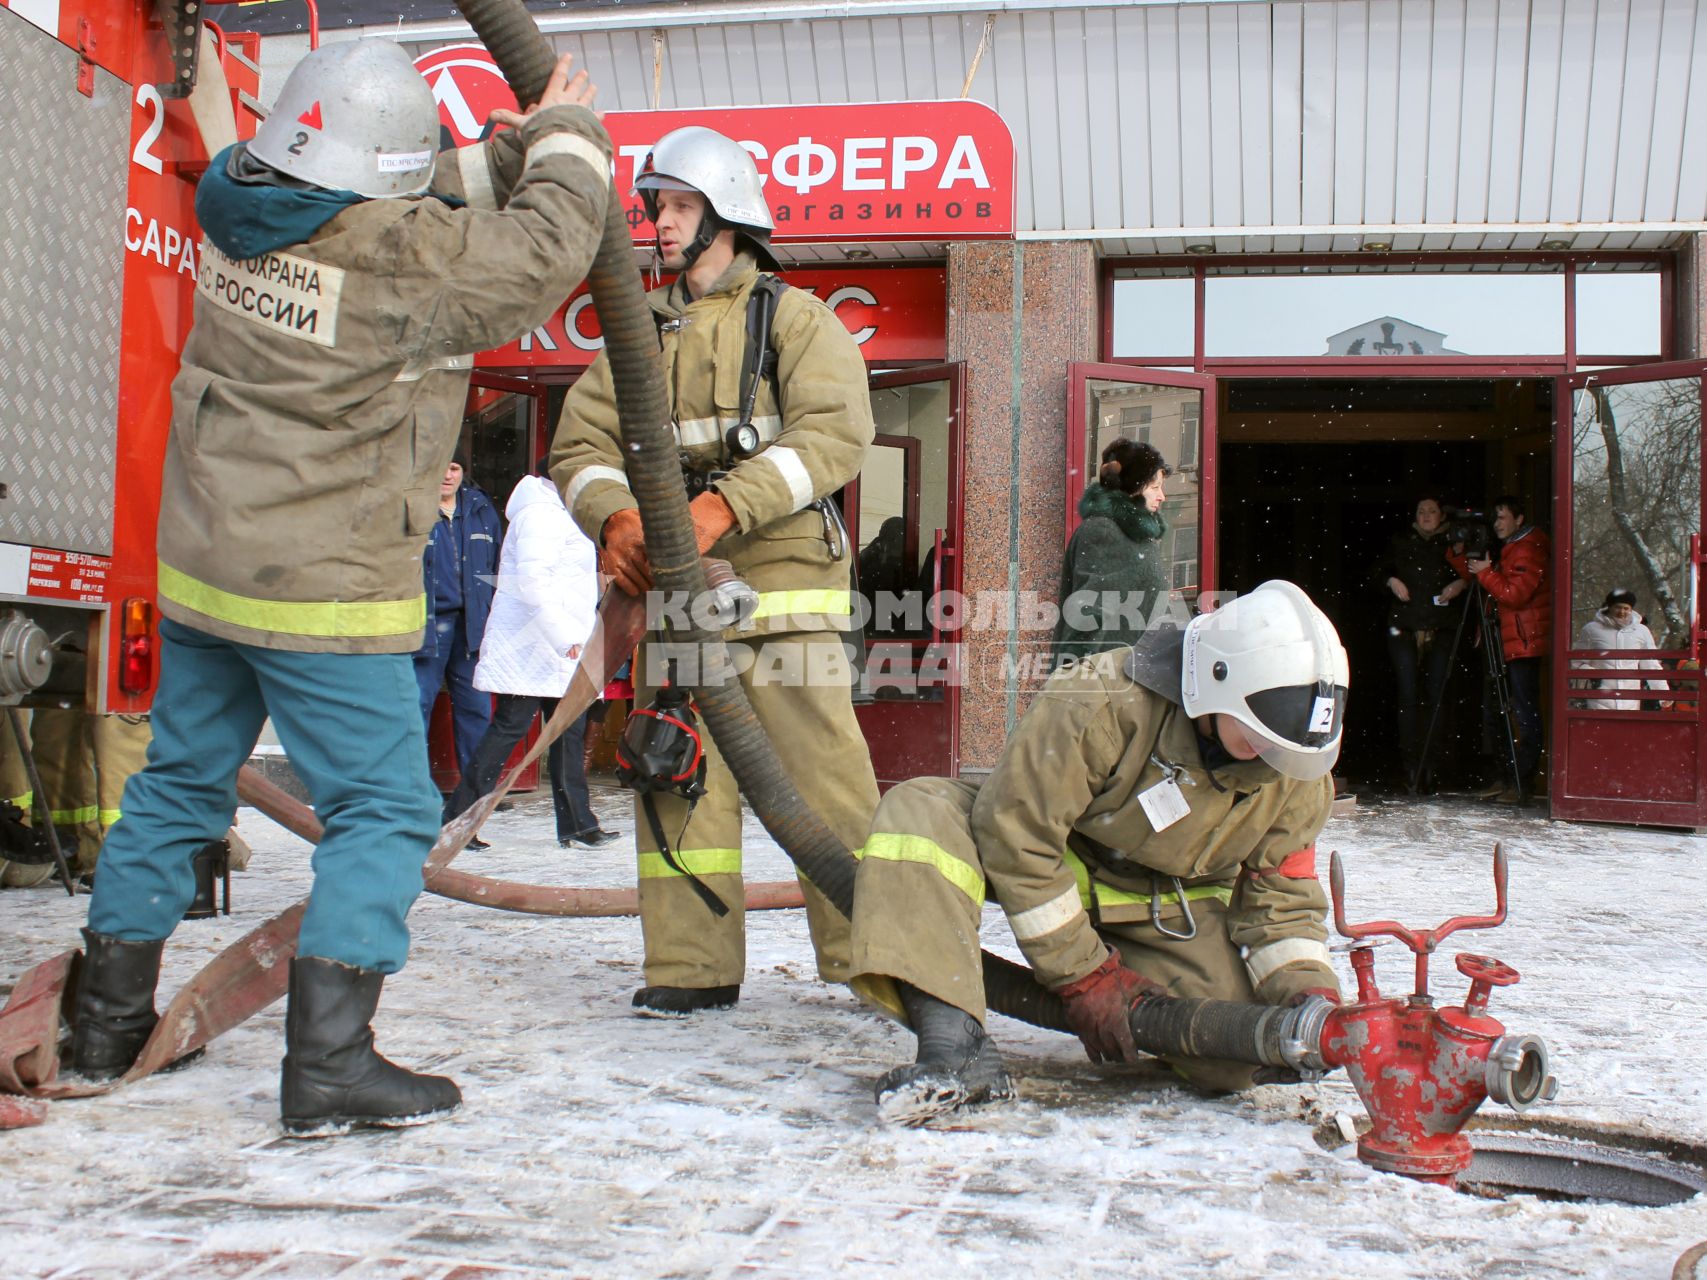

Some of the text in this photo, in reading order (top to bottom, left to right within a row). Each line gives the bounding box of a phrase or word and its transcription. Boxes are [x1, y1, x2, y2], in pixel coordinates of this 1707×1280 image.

[132, 83, 164, 176] 2
[287, 131, 309, 156] 2
[124, 207, 203, 283] САРА
[215, 272, 318, 335] РОССИИ
[1320, 707, 1332, 726] 2
